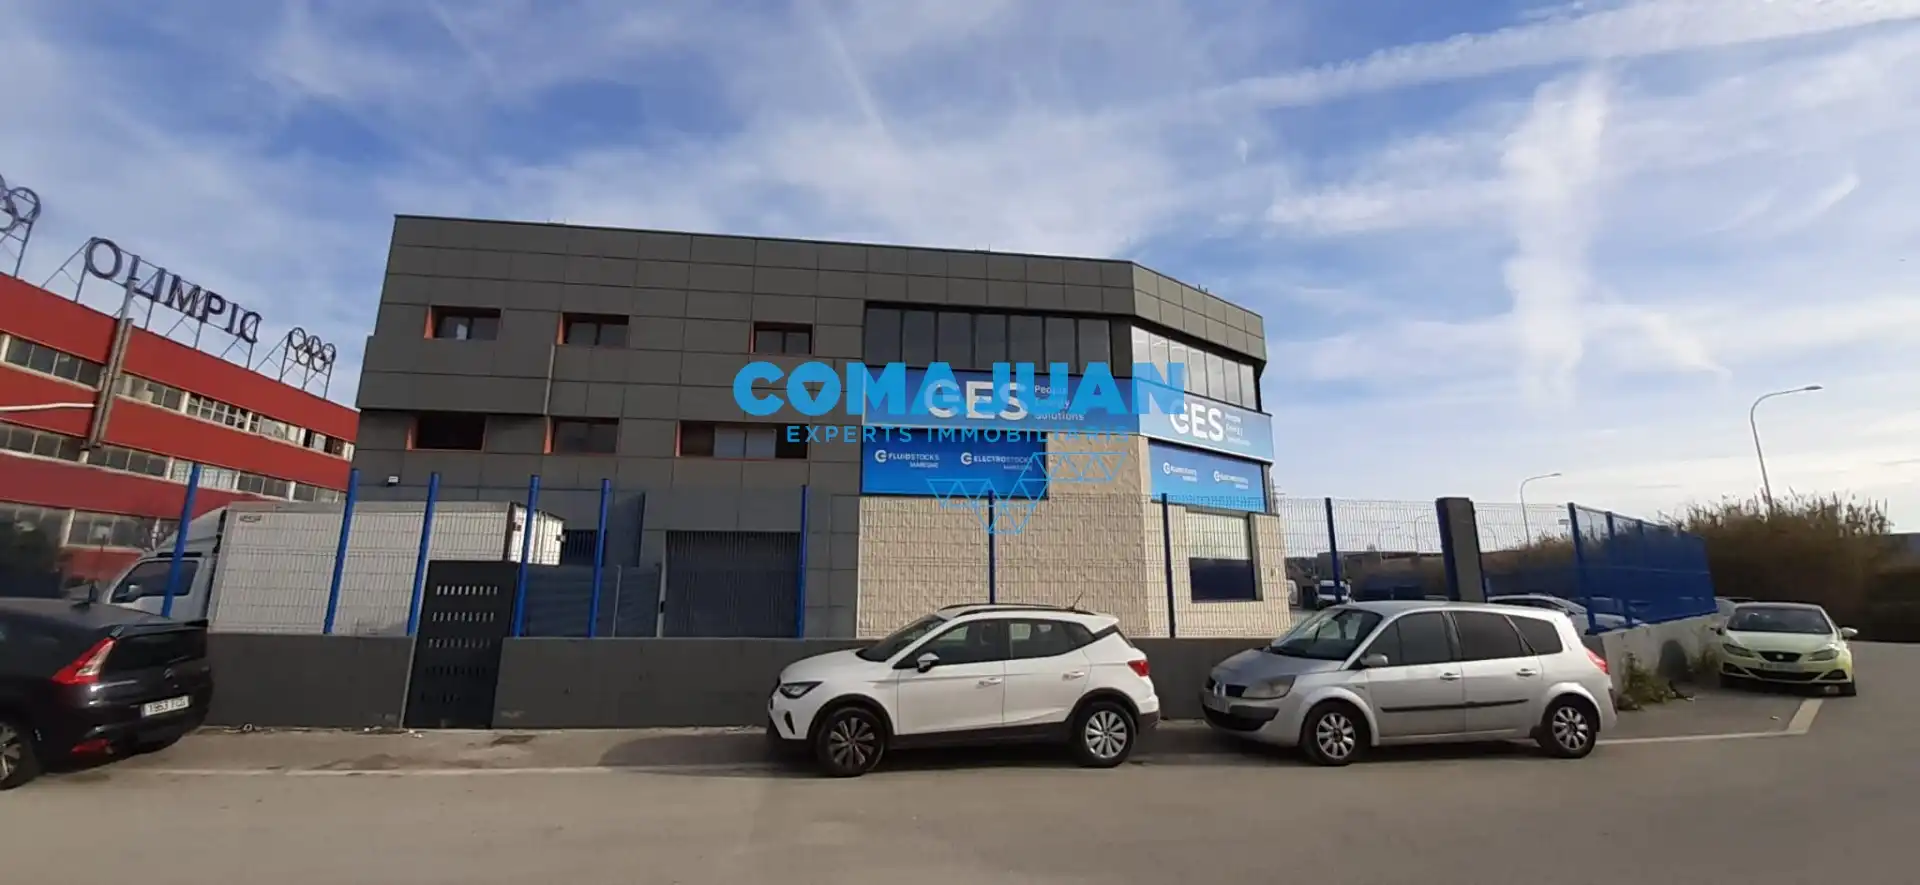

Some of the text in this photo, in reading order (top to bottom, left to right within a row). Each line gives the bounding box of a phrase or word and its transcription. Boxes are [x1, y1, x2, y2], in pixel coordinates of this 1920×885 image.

[85, 237, 263, 344] OLIMPIC
[923, 378, 1029, 421] GES
[1169, 398, 1224, 442] GES
